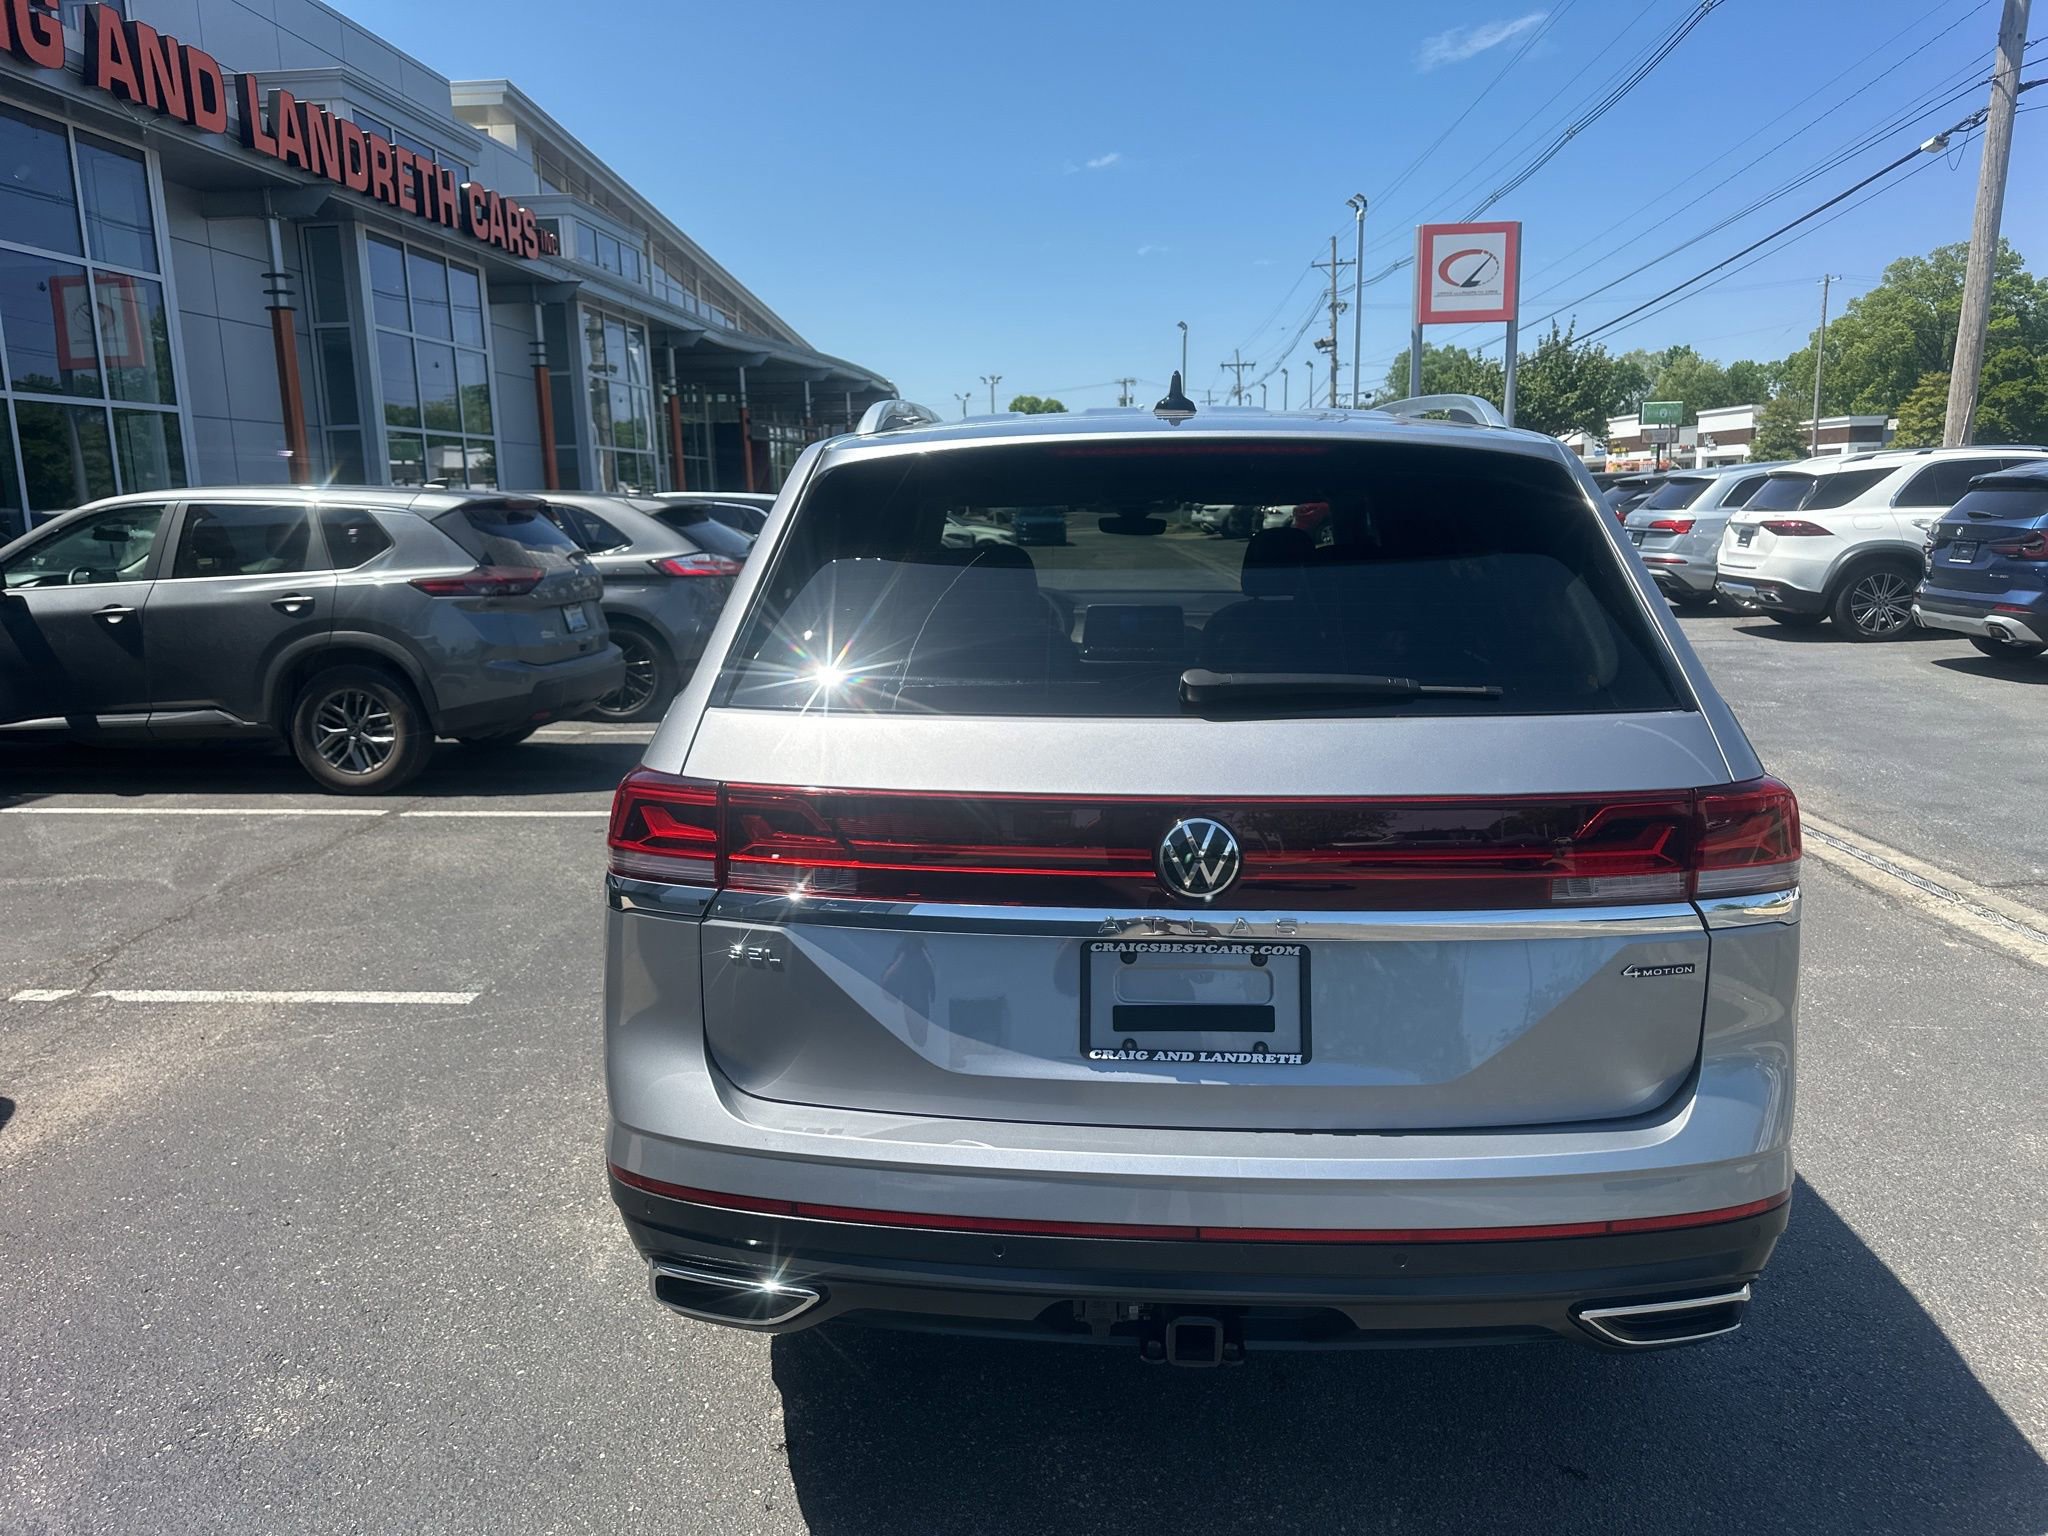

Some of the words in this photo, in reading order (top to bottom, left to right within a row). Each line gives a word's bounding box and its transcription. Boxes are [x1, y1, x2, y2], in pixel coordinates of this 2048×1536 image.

[98, 2, 228, 134] AND
[246, 72, 459, 230] LANDRETH
[468, 181, 539, 260] CARS
[1098, 915, 1299, 936] ATLAS
[1090, 942, 1301, 956] CRAIGSBESTCARS.COM
[1089, 1049, 1149, 1061] CRAIG
[1153, 1051, 1195, 1063] AND
[1199, 1052, 1303, 1065] LANDRETH
